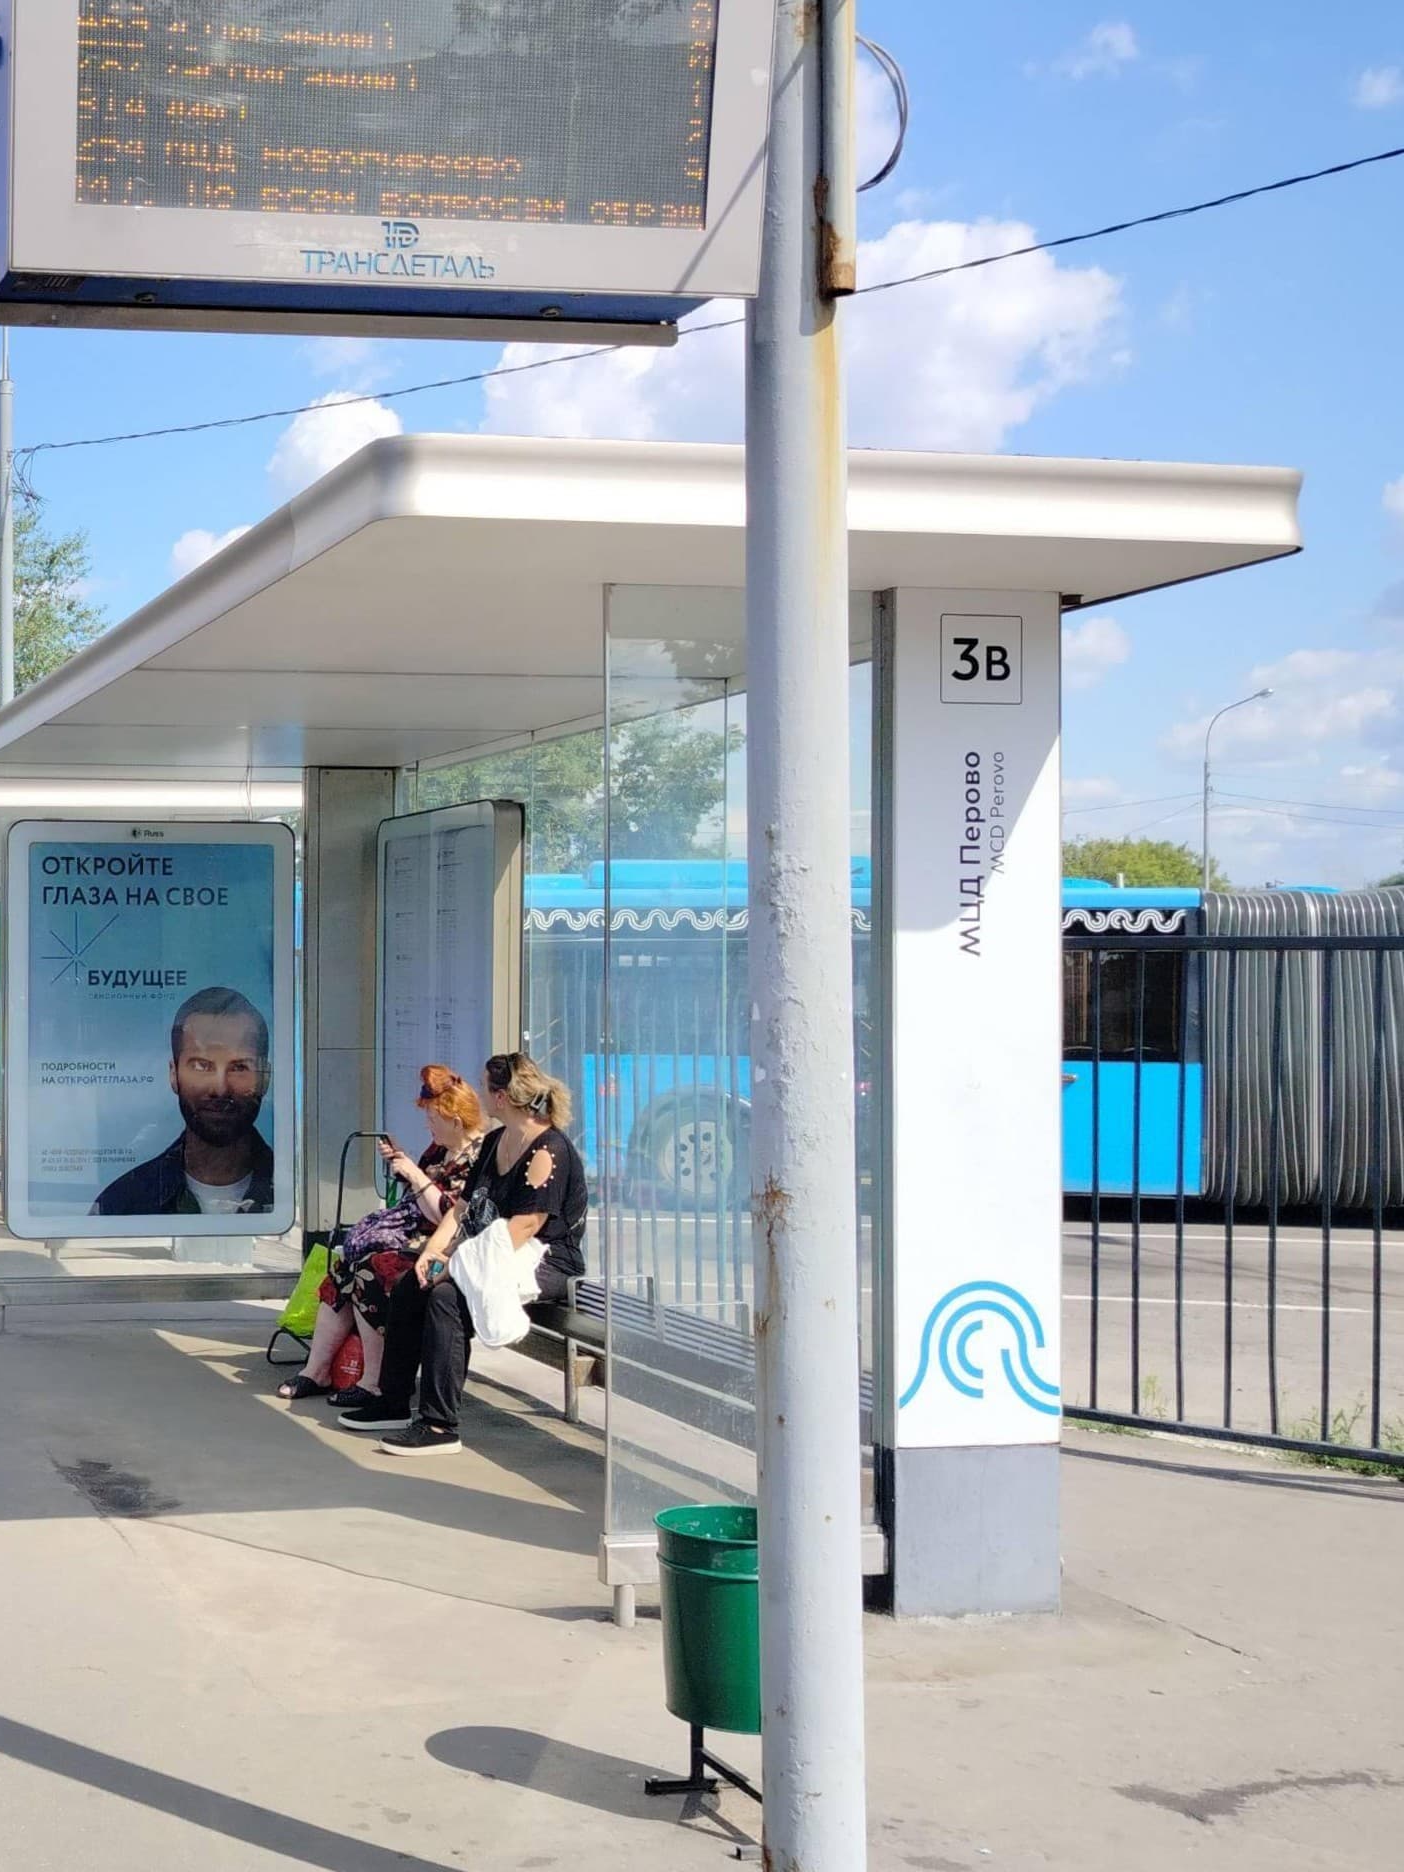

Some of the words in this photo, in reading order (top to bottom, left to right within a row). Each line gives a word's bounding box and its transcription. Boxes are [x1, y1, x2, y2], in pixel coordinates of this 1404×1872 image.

[299, 249, 496, 279] ТРАНСДЕТАЛЬ
[989, 751, 1006, 818] Perovo
[960, 751, 987, 865] Перово
[989, 825, 1006, 874] MCD
[42, 853, 174, 876] ОТКРОЙТЕ
[42, 886, 119, 905] ГЛАЗА
[126, 887, 161, 905] НА
[166, 887, 229, 906] СВОЕ
[960, 875, 985, 957] МЦД
[87, 970, 188, 988] БУДУЩЕЕ
[41, 1062, 116, 1071] ПОДРОБНОСТИ
[41, 1076, 56, 1084] НА
